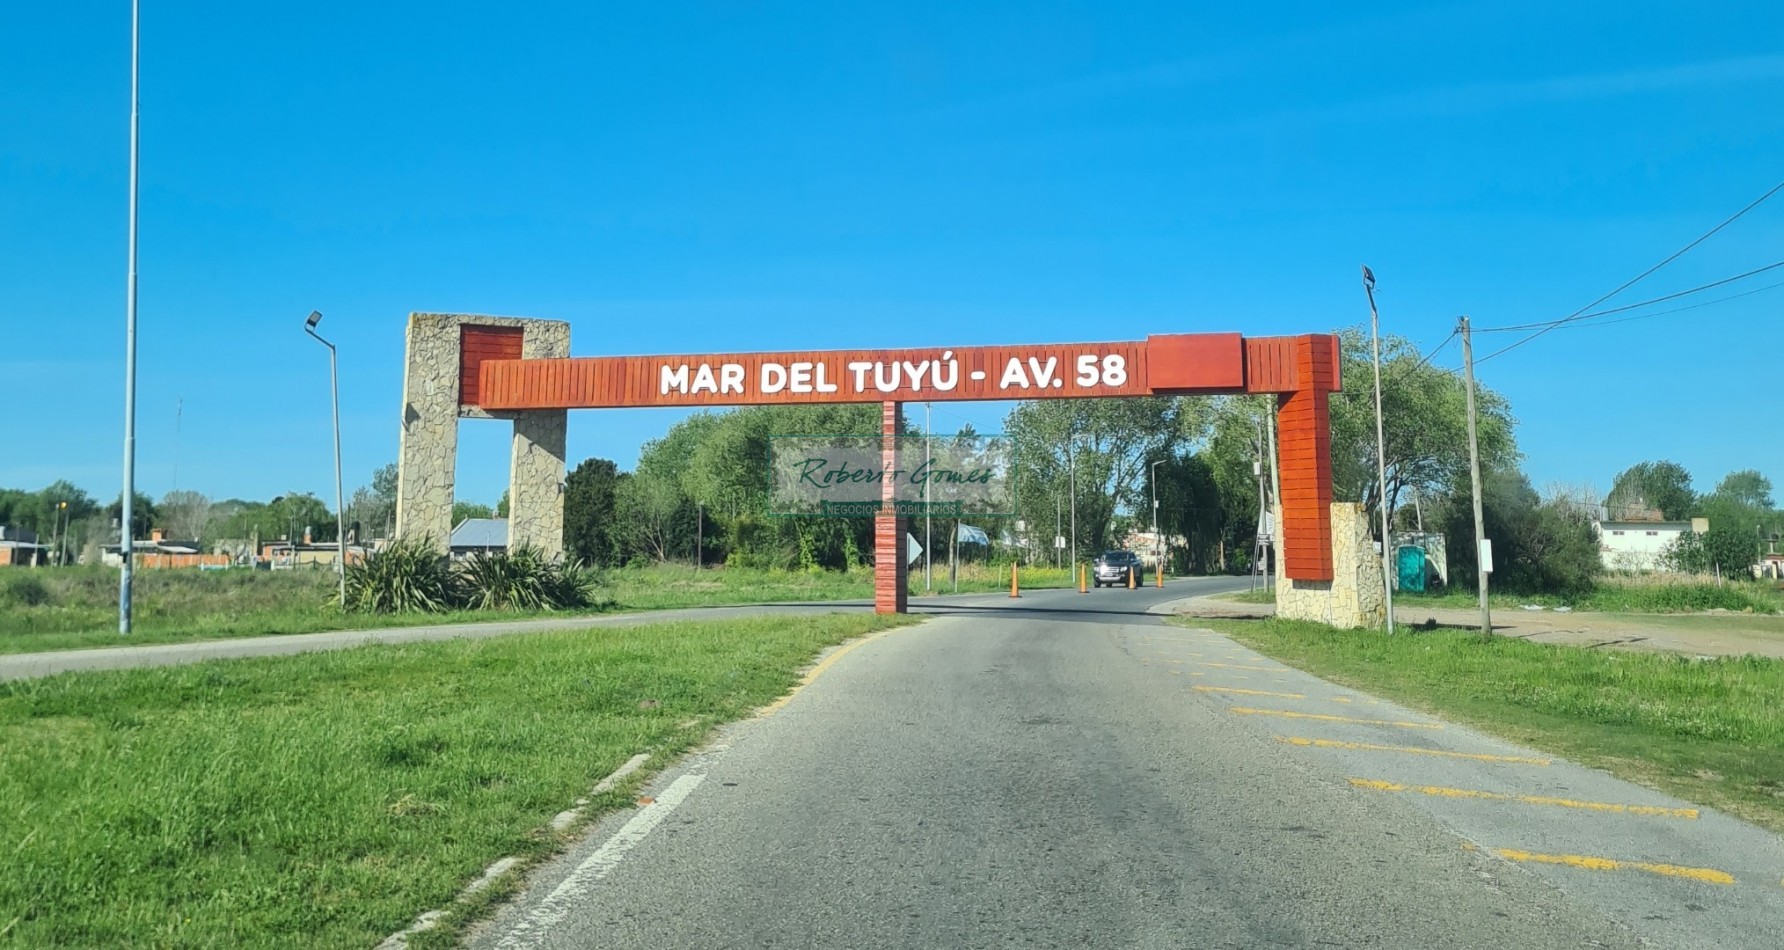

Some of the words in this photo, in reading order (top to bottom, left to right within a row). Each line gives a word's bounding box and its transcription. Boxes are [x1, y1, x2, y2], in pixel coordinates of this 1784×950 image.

[660, 363, 746, 395] MAR
[760, 361, 838, 394] DEL
[848, 350, 959, 393] TUYÚ
[970, 370, 986, 381] -
[999, 356, 1063, 390] AV.
[1076, 353, 1128, 388] 58
